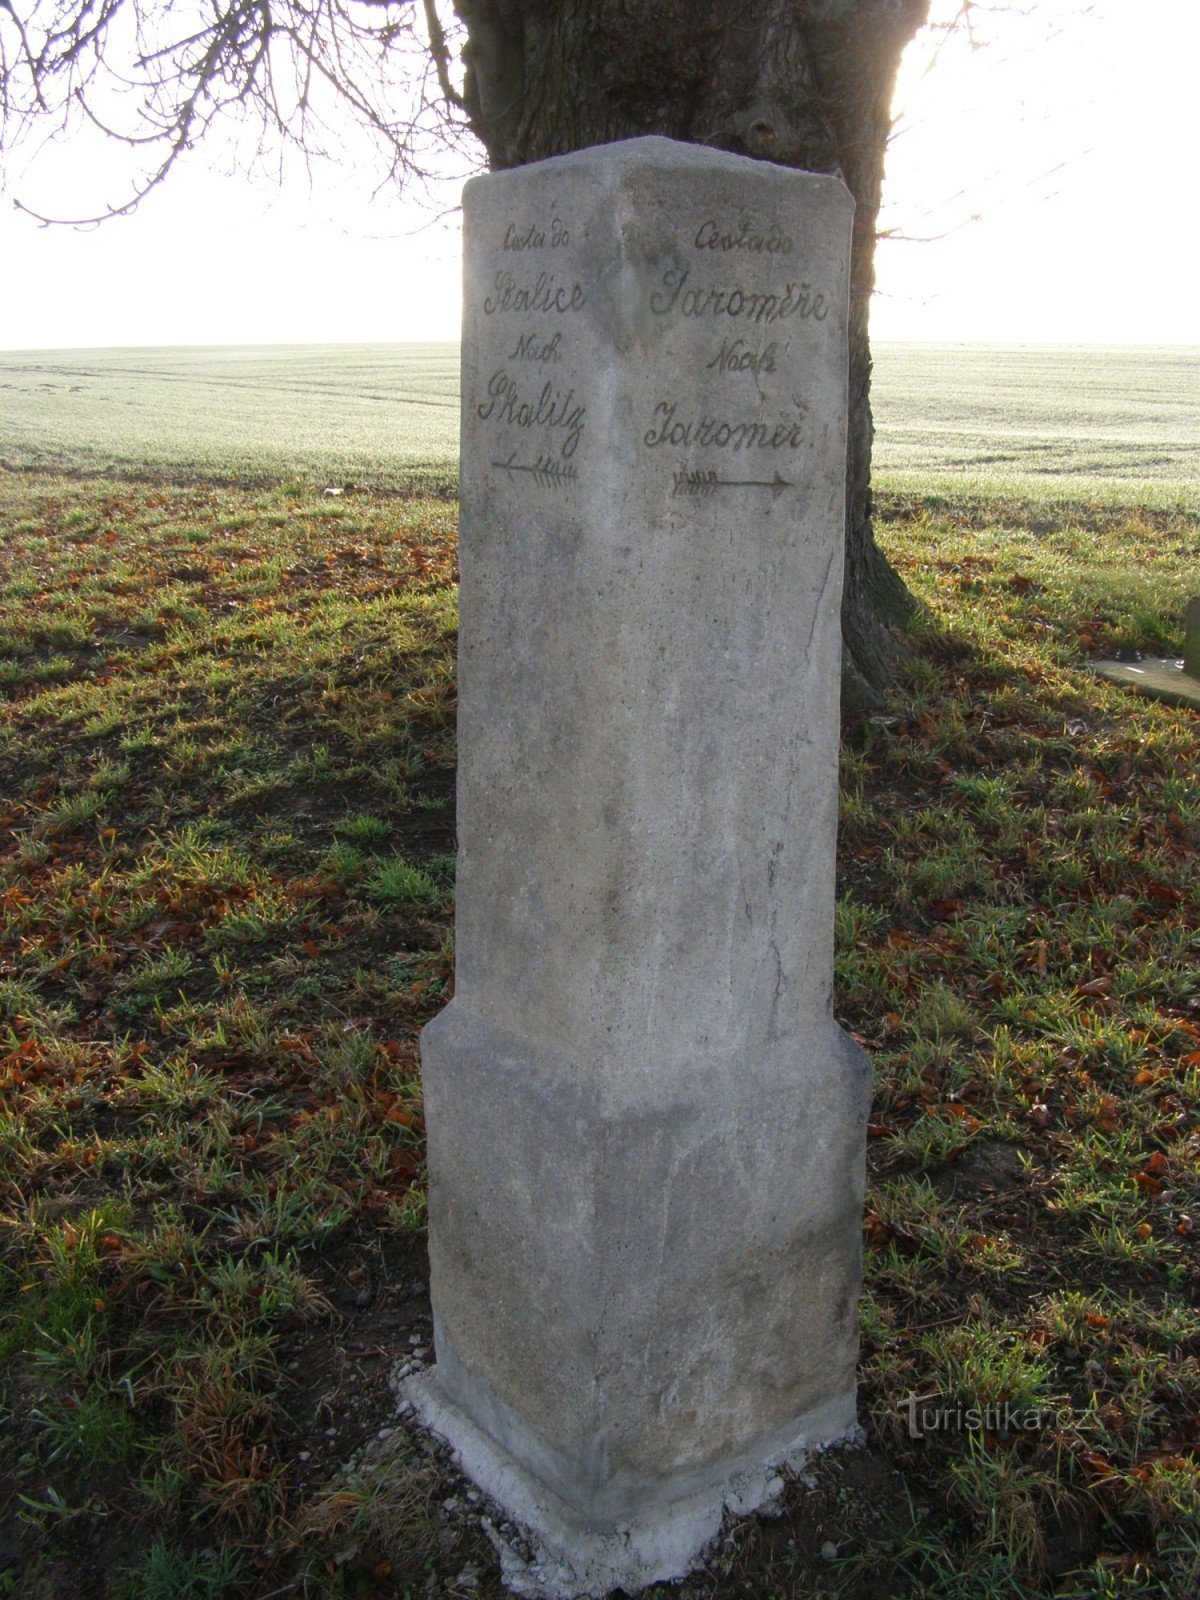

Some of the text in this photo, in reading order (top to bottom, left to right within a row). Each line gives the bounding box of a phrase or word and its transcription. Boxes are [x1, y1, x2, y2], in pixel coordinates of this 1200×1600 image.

[550, 217, 570, 249] do
[508, 332, 562, 363] Nach
[706, 337, 778, 375] Nach
